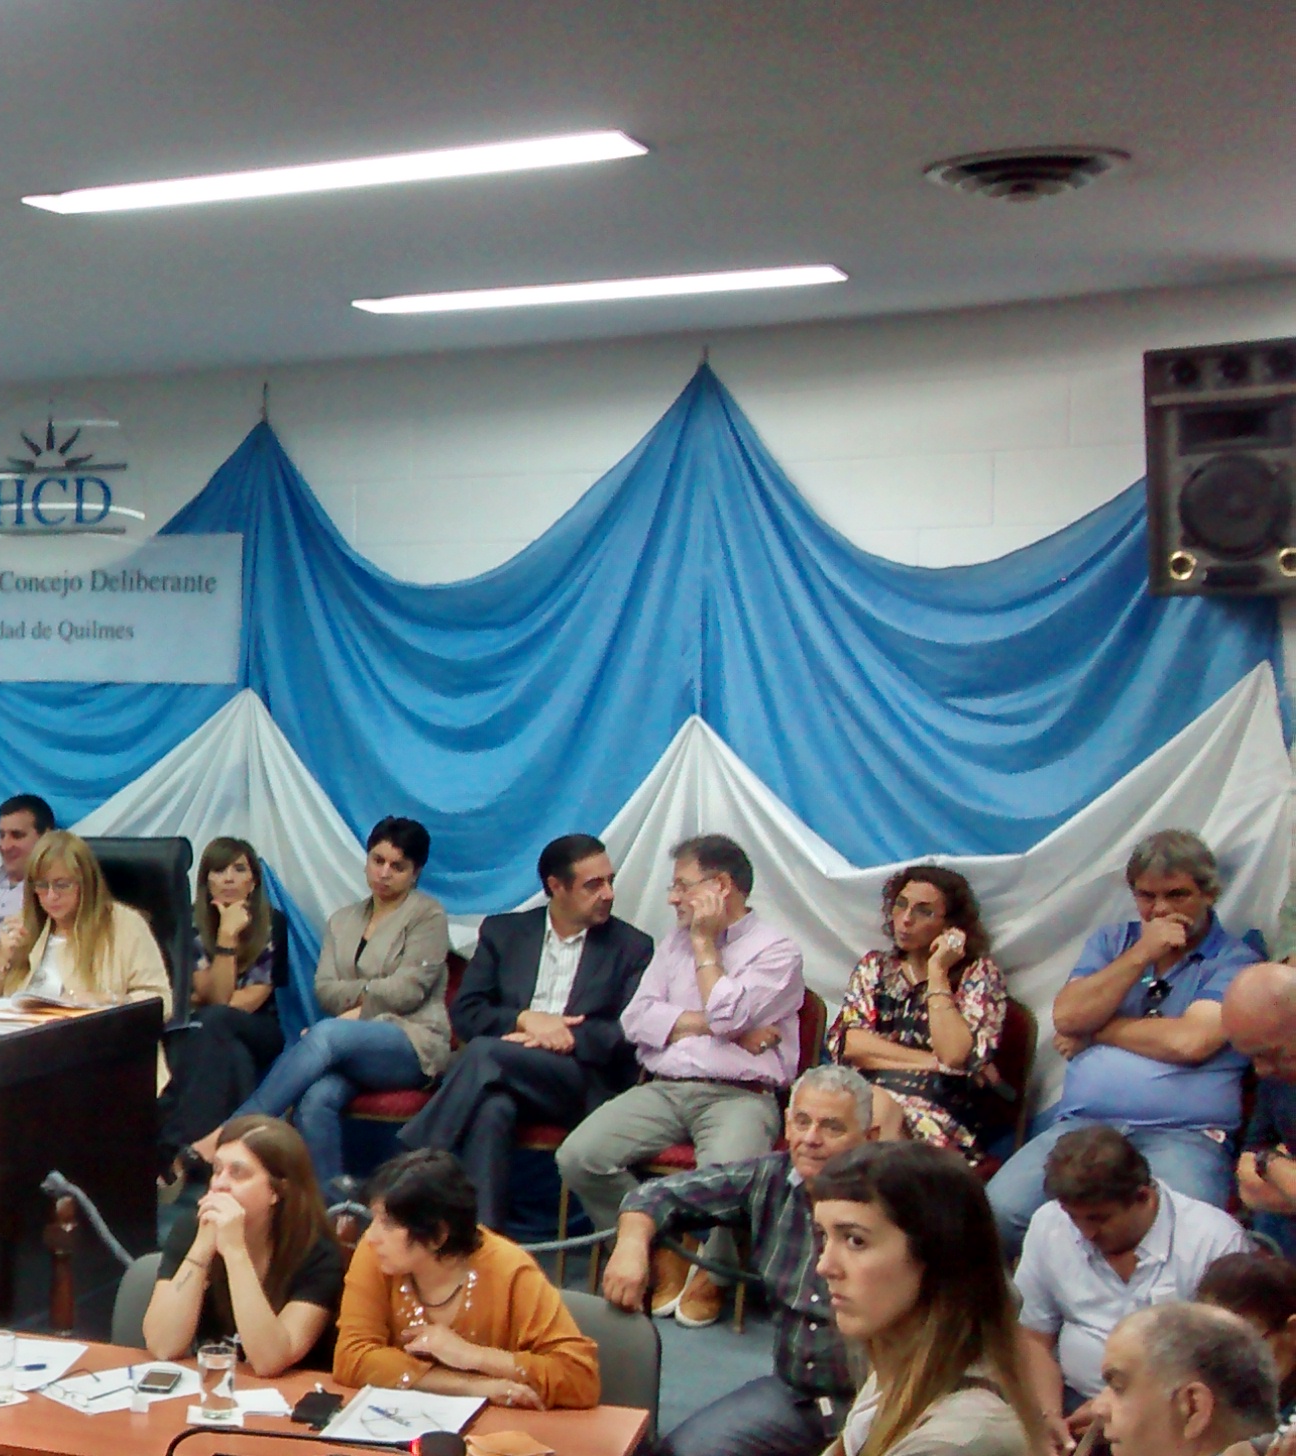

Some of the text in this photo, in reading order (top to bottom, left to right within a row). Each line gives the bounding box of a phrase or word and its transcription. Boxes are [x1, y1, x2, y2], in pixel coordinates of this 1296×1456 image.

[91, 568, 217, 594] Deliberante
[30, 620, 53, 641] de
[57, 618, 135, 645] Quilmes
